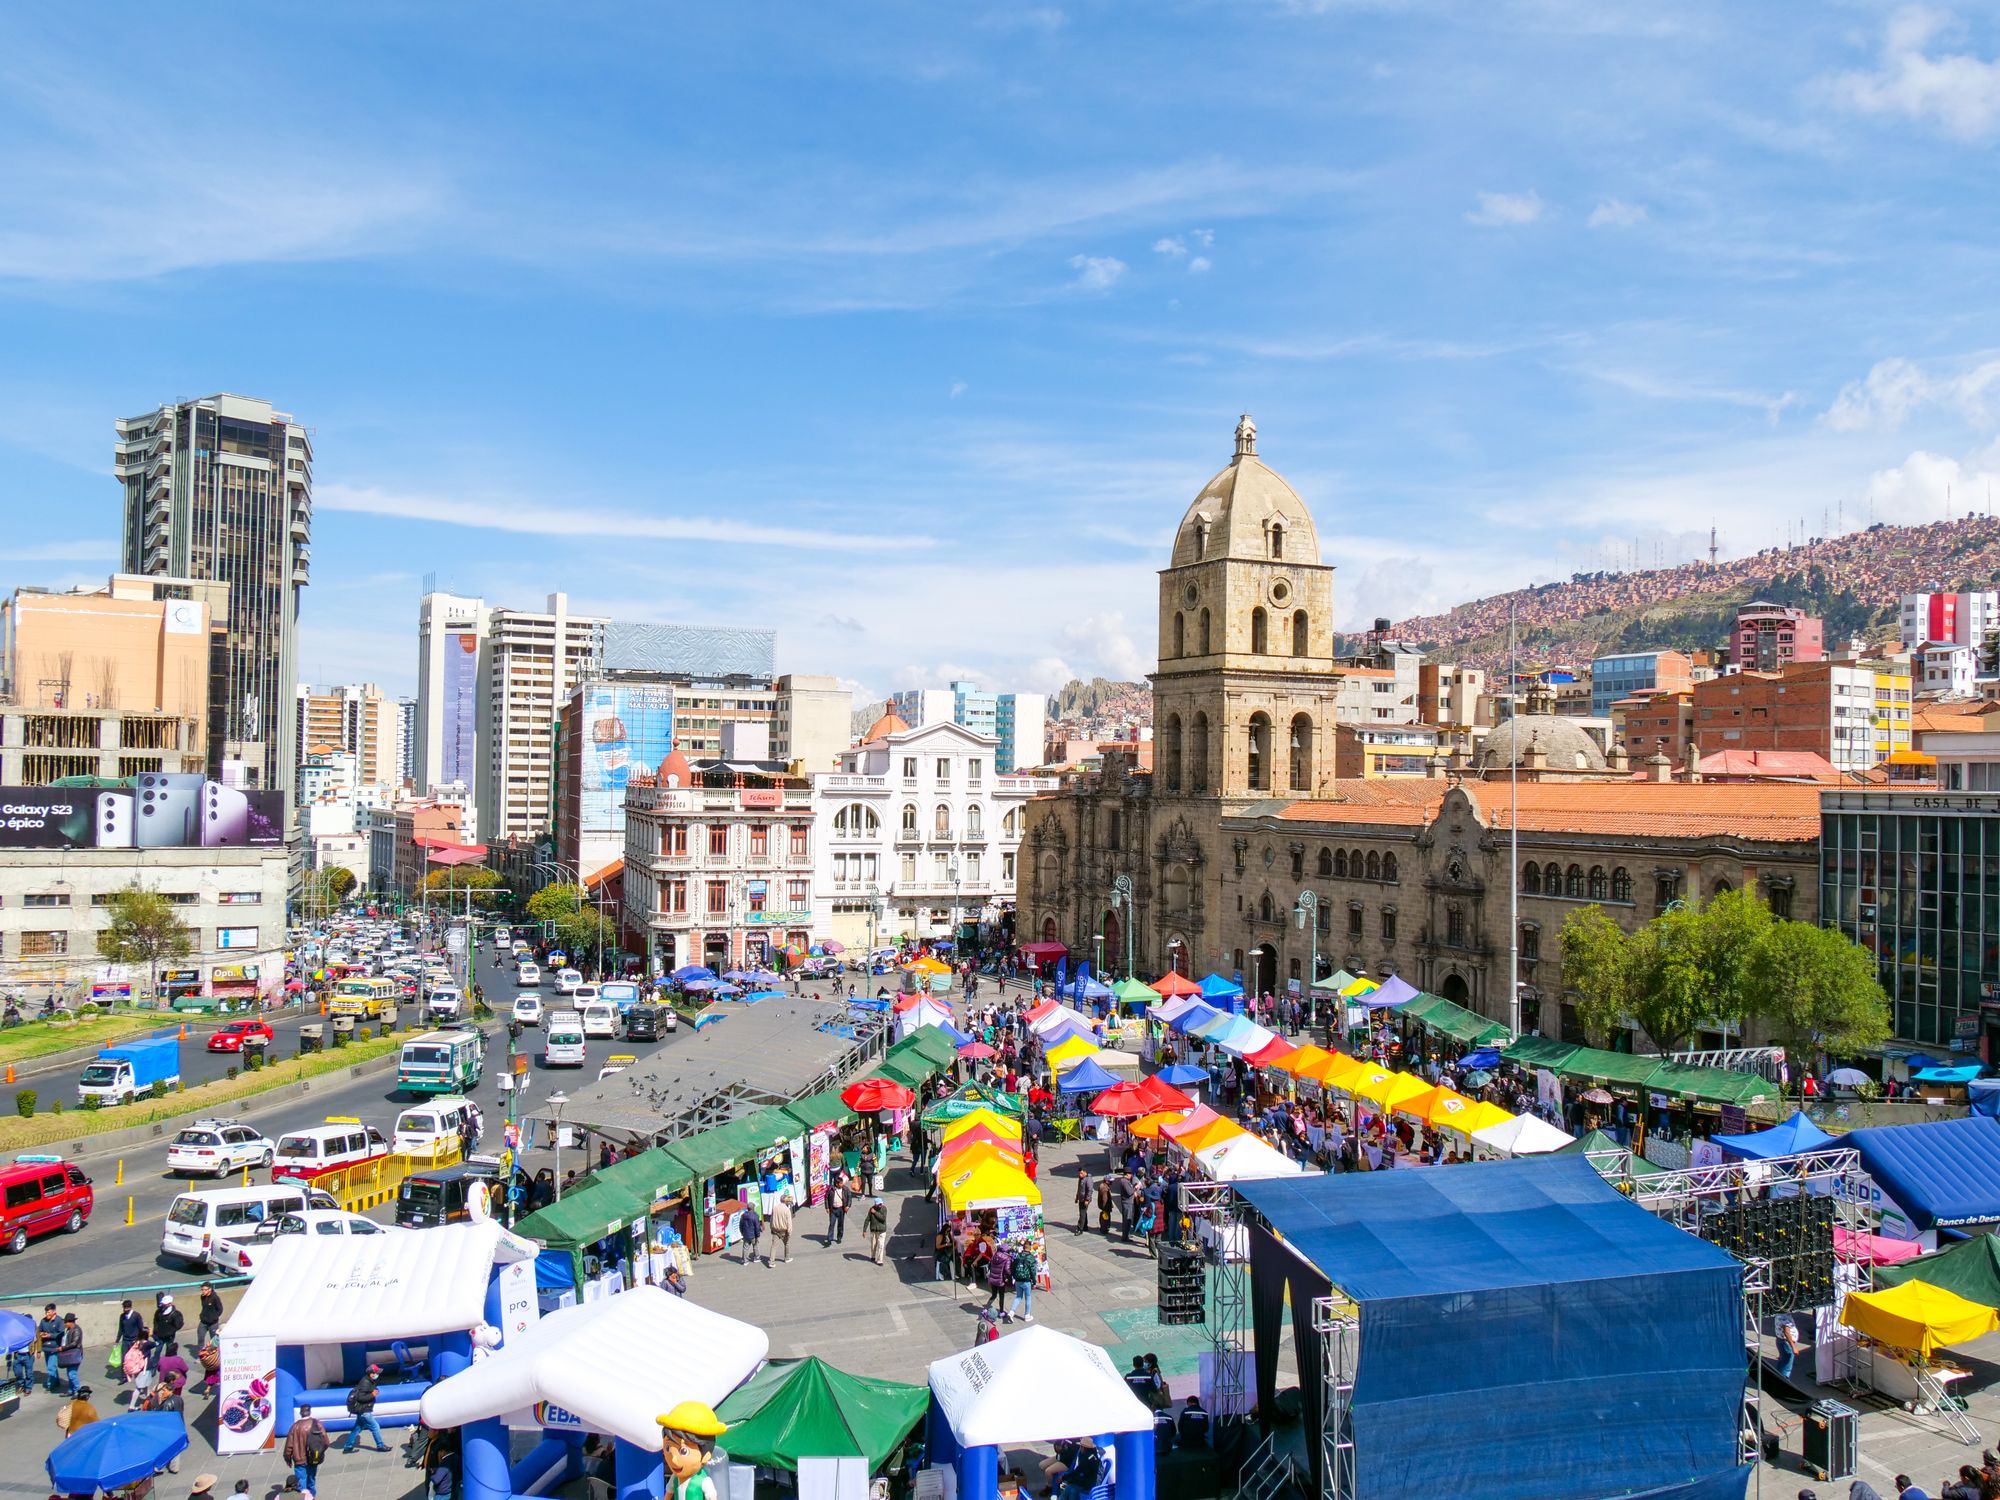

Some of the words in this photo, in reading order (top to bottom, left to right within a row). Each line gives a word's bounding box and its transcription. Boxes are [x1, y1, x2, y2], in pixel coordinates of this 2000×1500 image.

[1914, 797, 1950, 809] CASA
[1966, 798, 1981, 809] DE
[3, 804, 50, 817] Galaxy
[51, 805, 73, 815] S23
[8, 817, 45, 831] épico
[1077, 975, 1087, 993] tigo
[1936, 1219, 1964, 1227] Banco
[1966, 1217, 1977, 1225] de
[509, 1300, 528, 1313] pro
[232, 1373, 255, 1381] BOLIVIA
[547, 1405, 581, 1424] EBA
